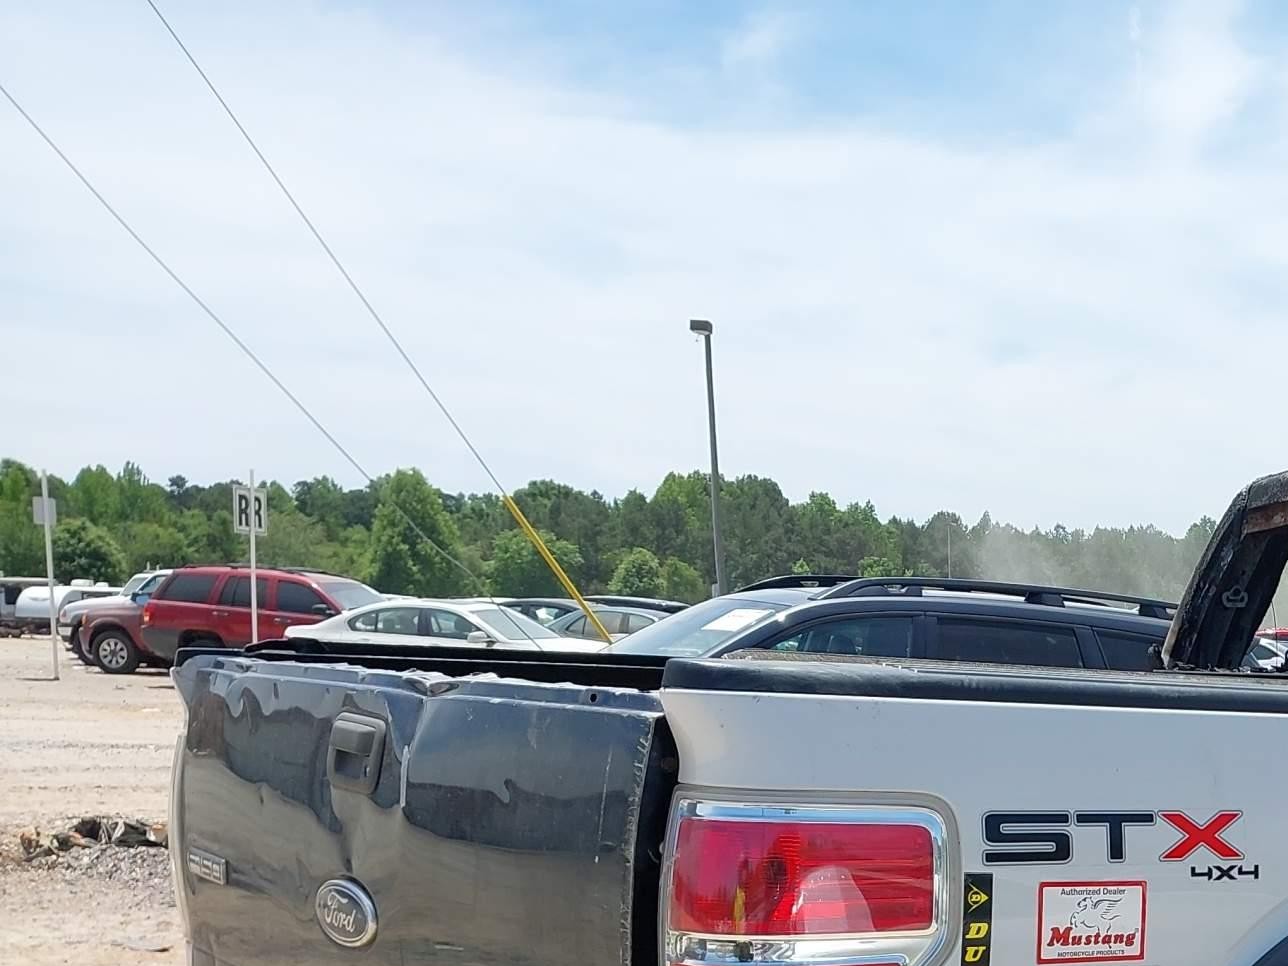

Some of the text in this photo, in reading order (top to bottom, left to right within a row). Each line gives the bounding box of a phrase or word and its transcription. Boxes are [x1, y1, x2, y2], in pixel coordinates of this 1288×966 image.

[238, 494, 262, 529] RR
[981, 810, 1244, 866] STX
[1060, 887, 1126, 896] Authorized Dealer
[324, 891, 356, 933] Ford
[1047, 926, 1137, 948] Mustang
